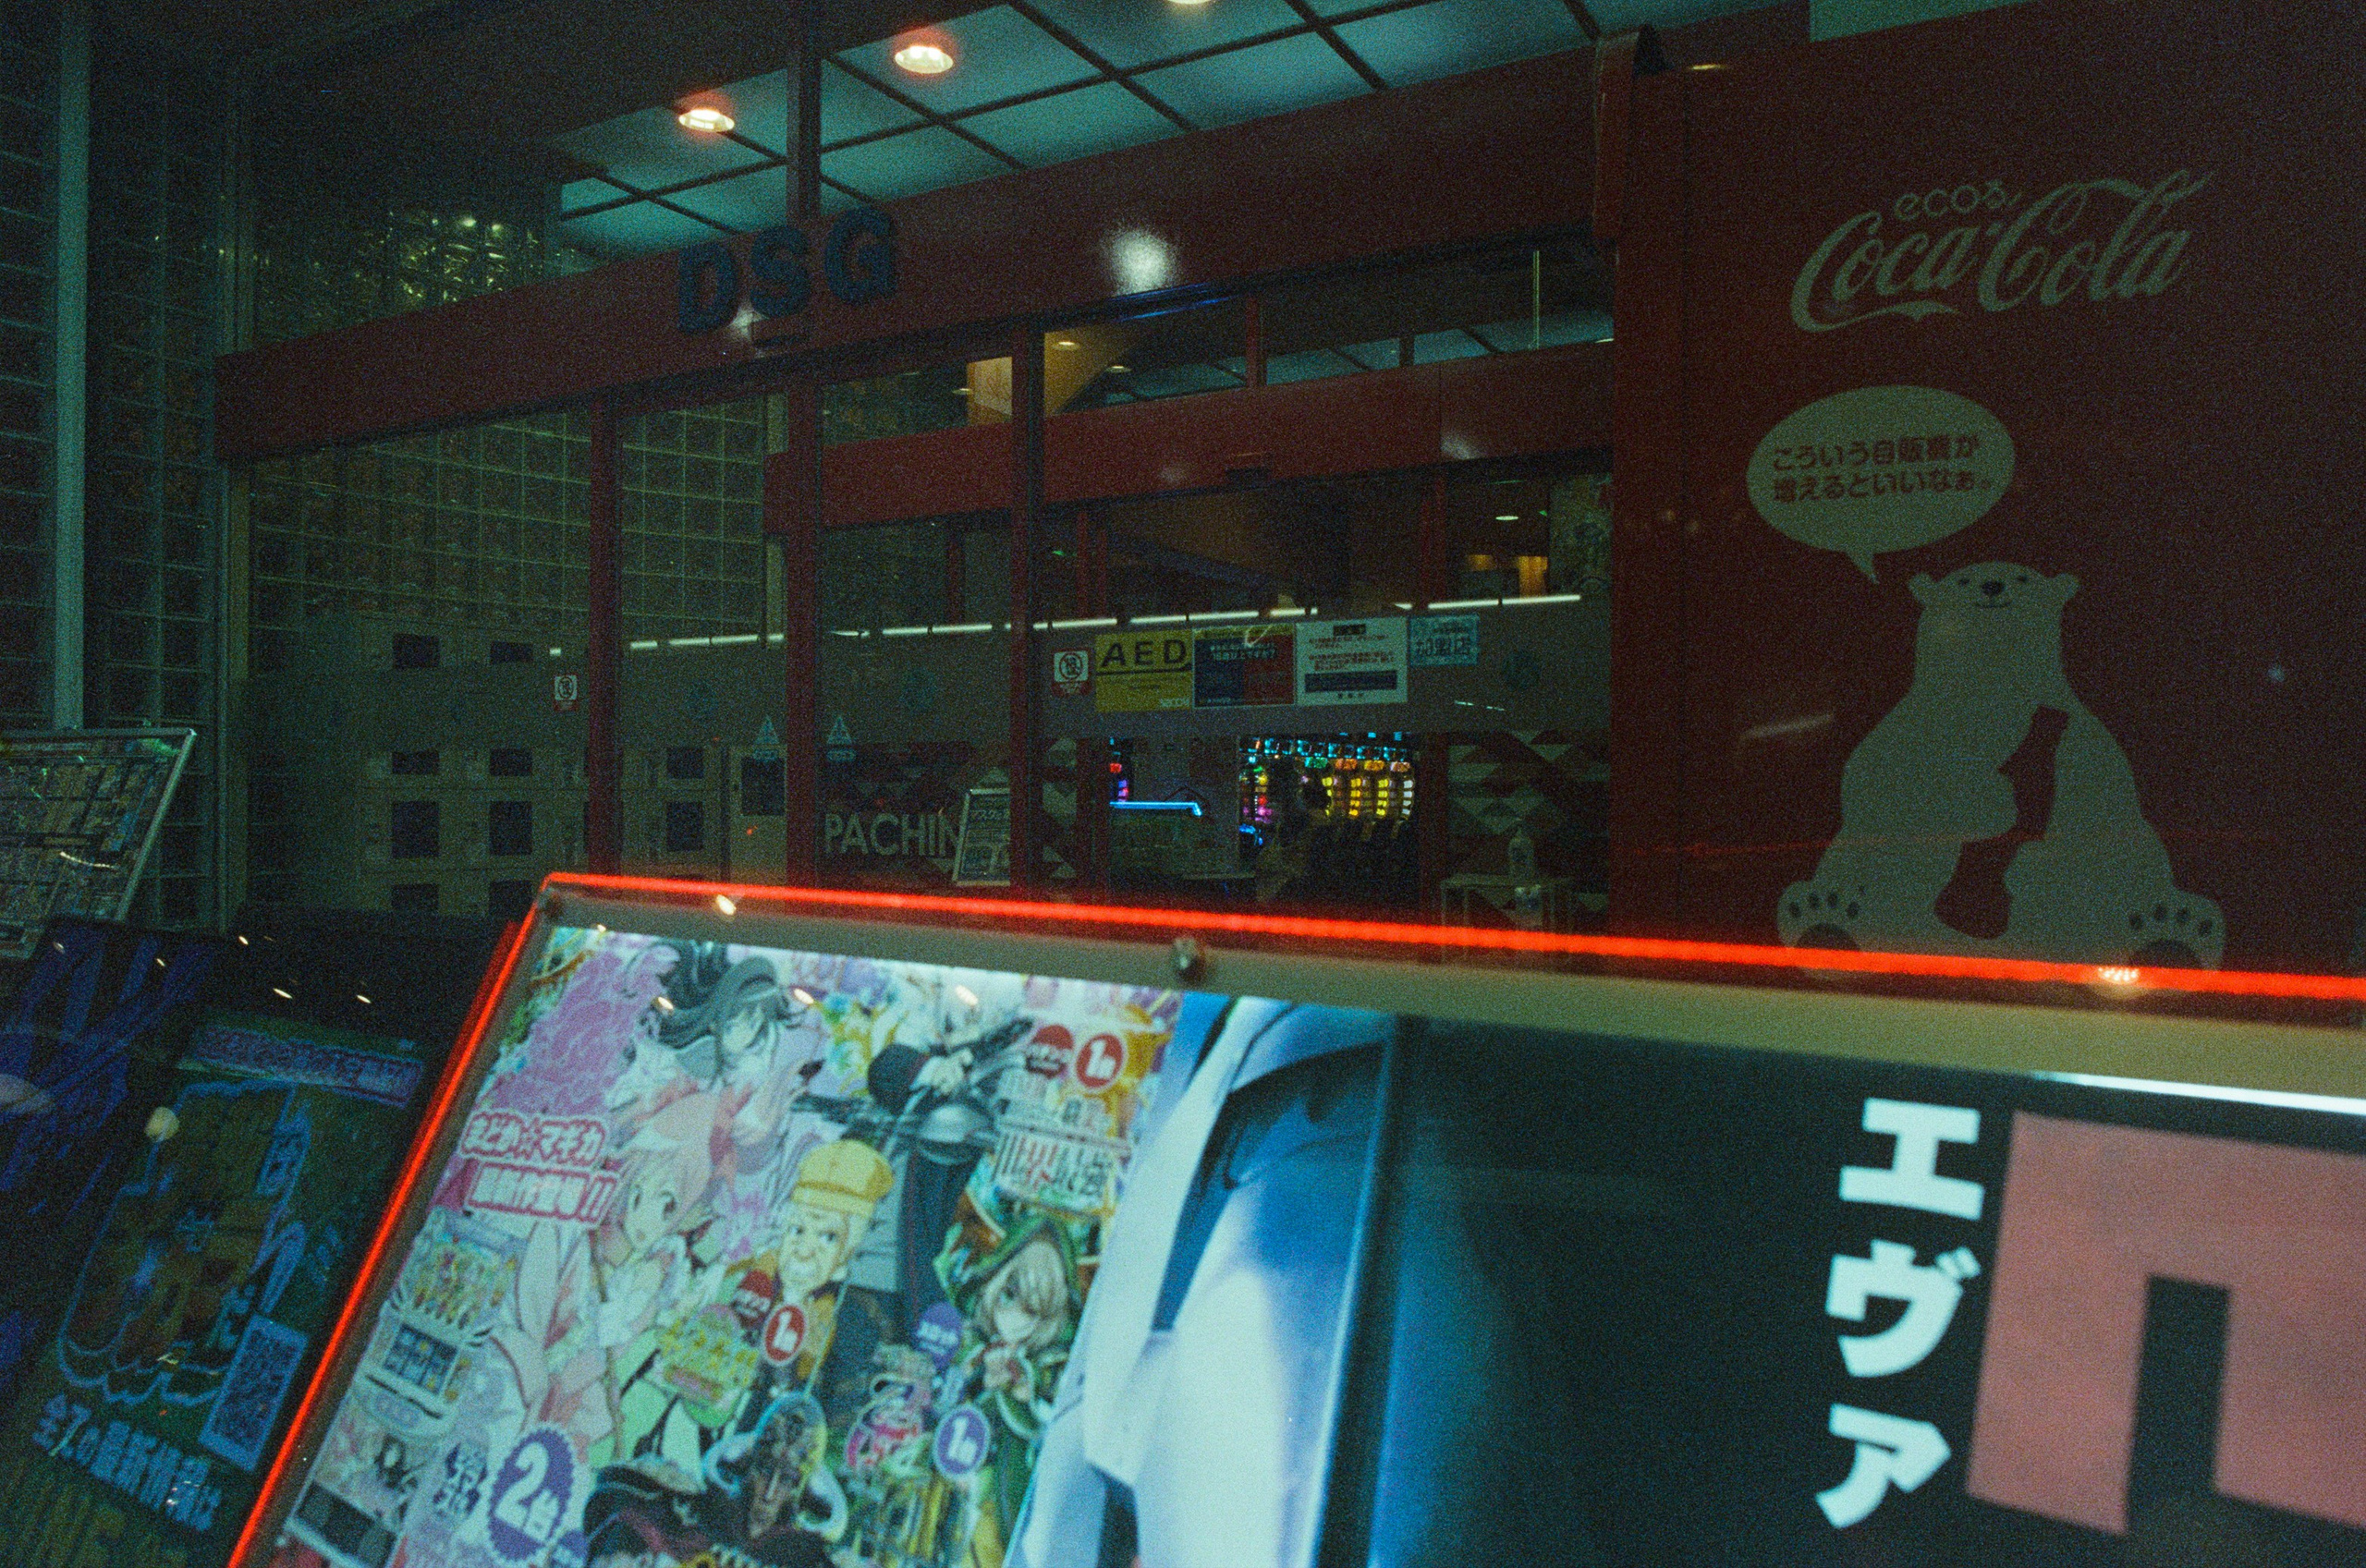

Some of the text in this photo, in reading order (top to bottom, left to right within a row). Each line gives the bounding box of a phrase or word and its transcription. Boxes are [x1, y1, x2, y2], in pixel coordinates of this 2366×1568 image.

[677, 205, 897, 336] DSG
[1790, 168, 2215, 334] Coca-Cola
[1773, 433, 1980, 472] こういう自販機が
[1100, 638, 1187, 668] AED
